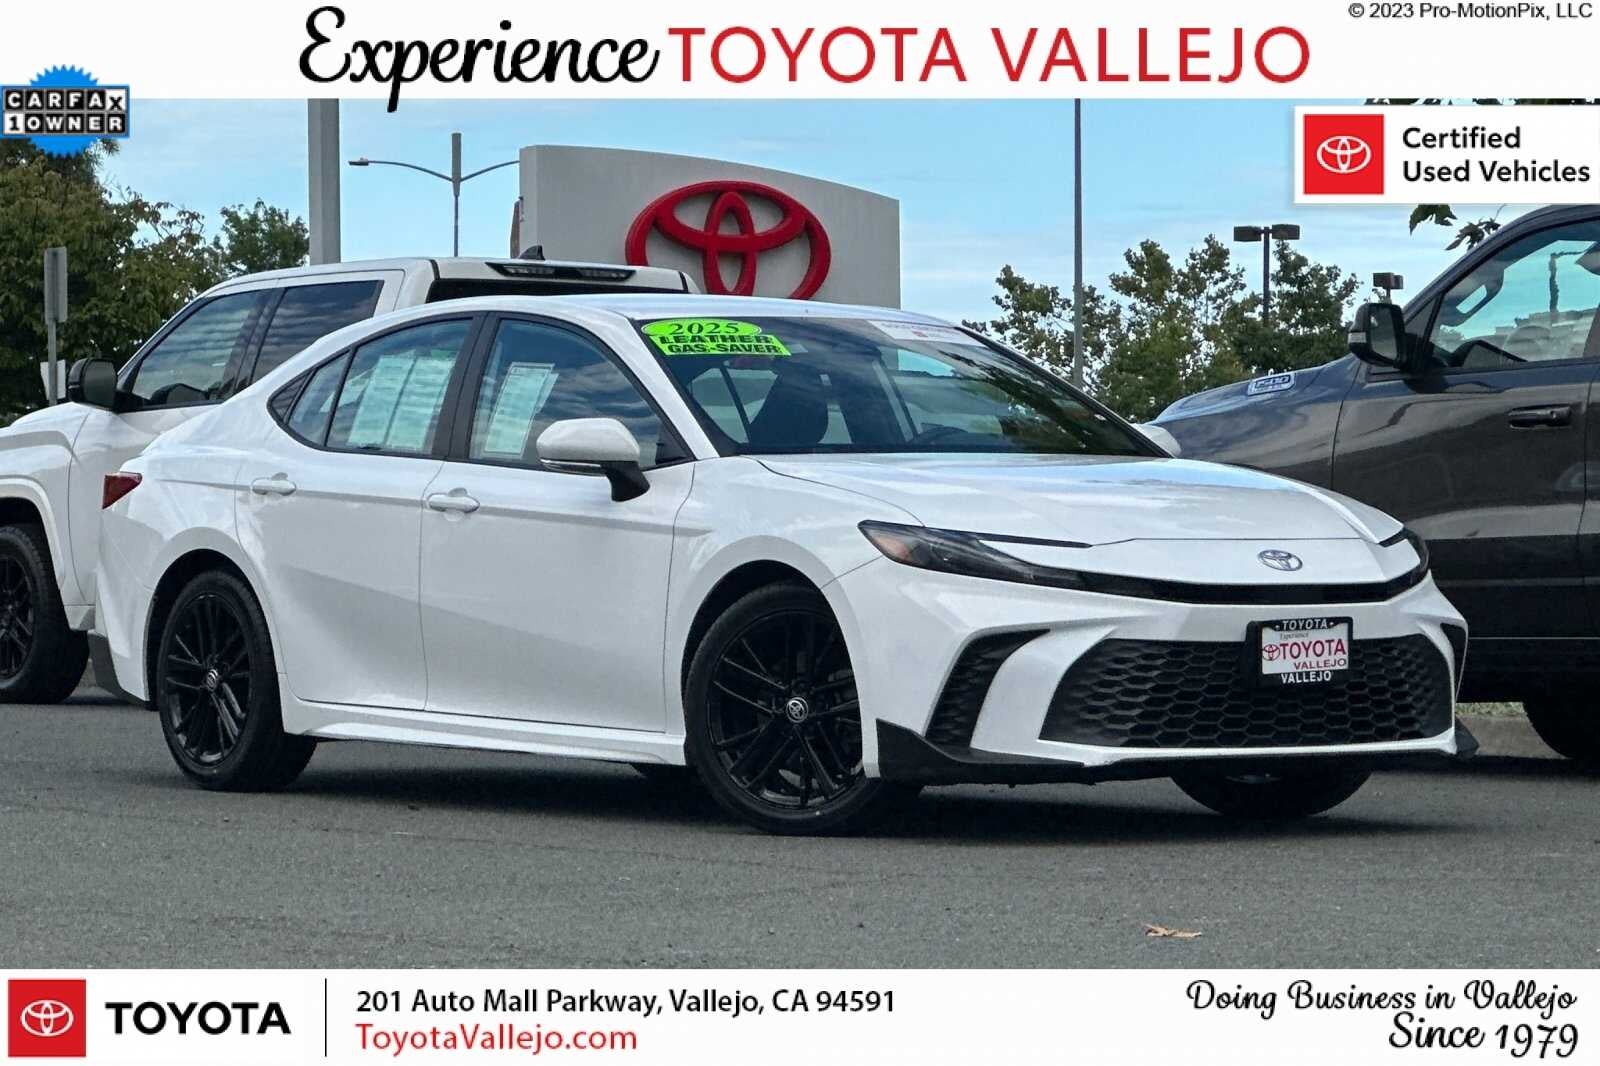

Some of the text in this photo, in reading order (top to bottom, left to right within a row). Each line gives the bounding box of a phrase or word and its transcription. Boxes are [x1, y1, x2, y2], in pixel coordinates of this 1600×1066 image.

[668, 322, 740, 335] 2025
[659, 334, 774, 344] LEATHER
[1283, 619, 1328, 630] TOYOTA
[1280, 639, 1346, 660] TOYOTA
[1294, 658, 1347, 670] VALLEJO
[1280, 670, 1332, 684] VALLEJO
